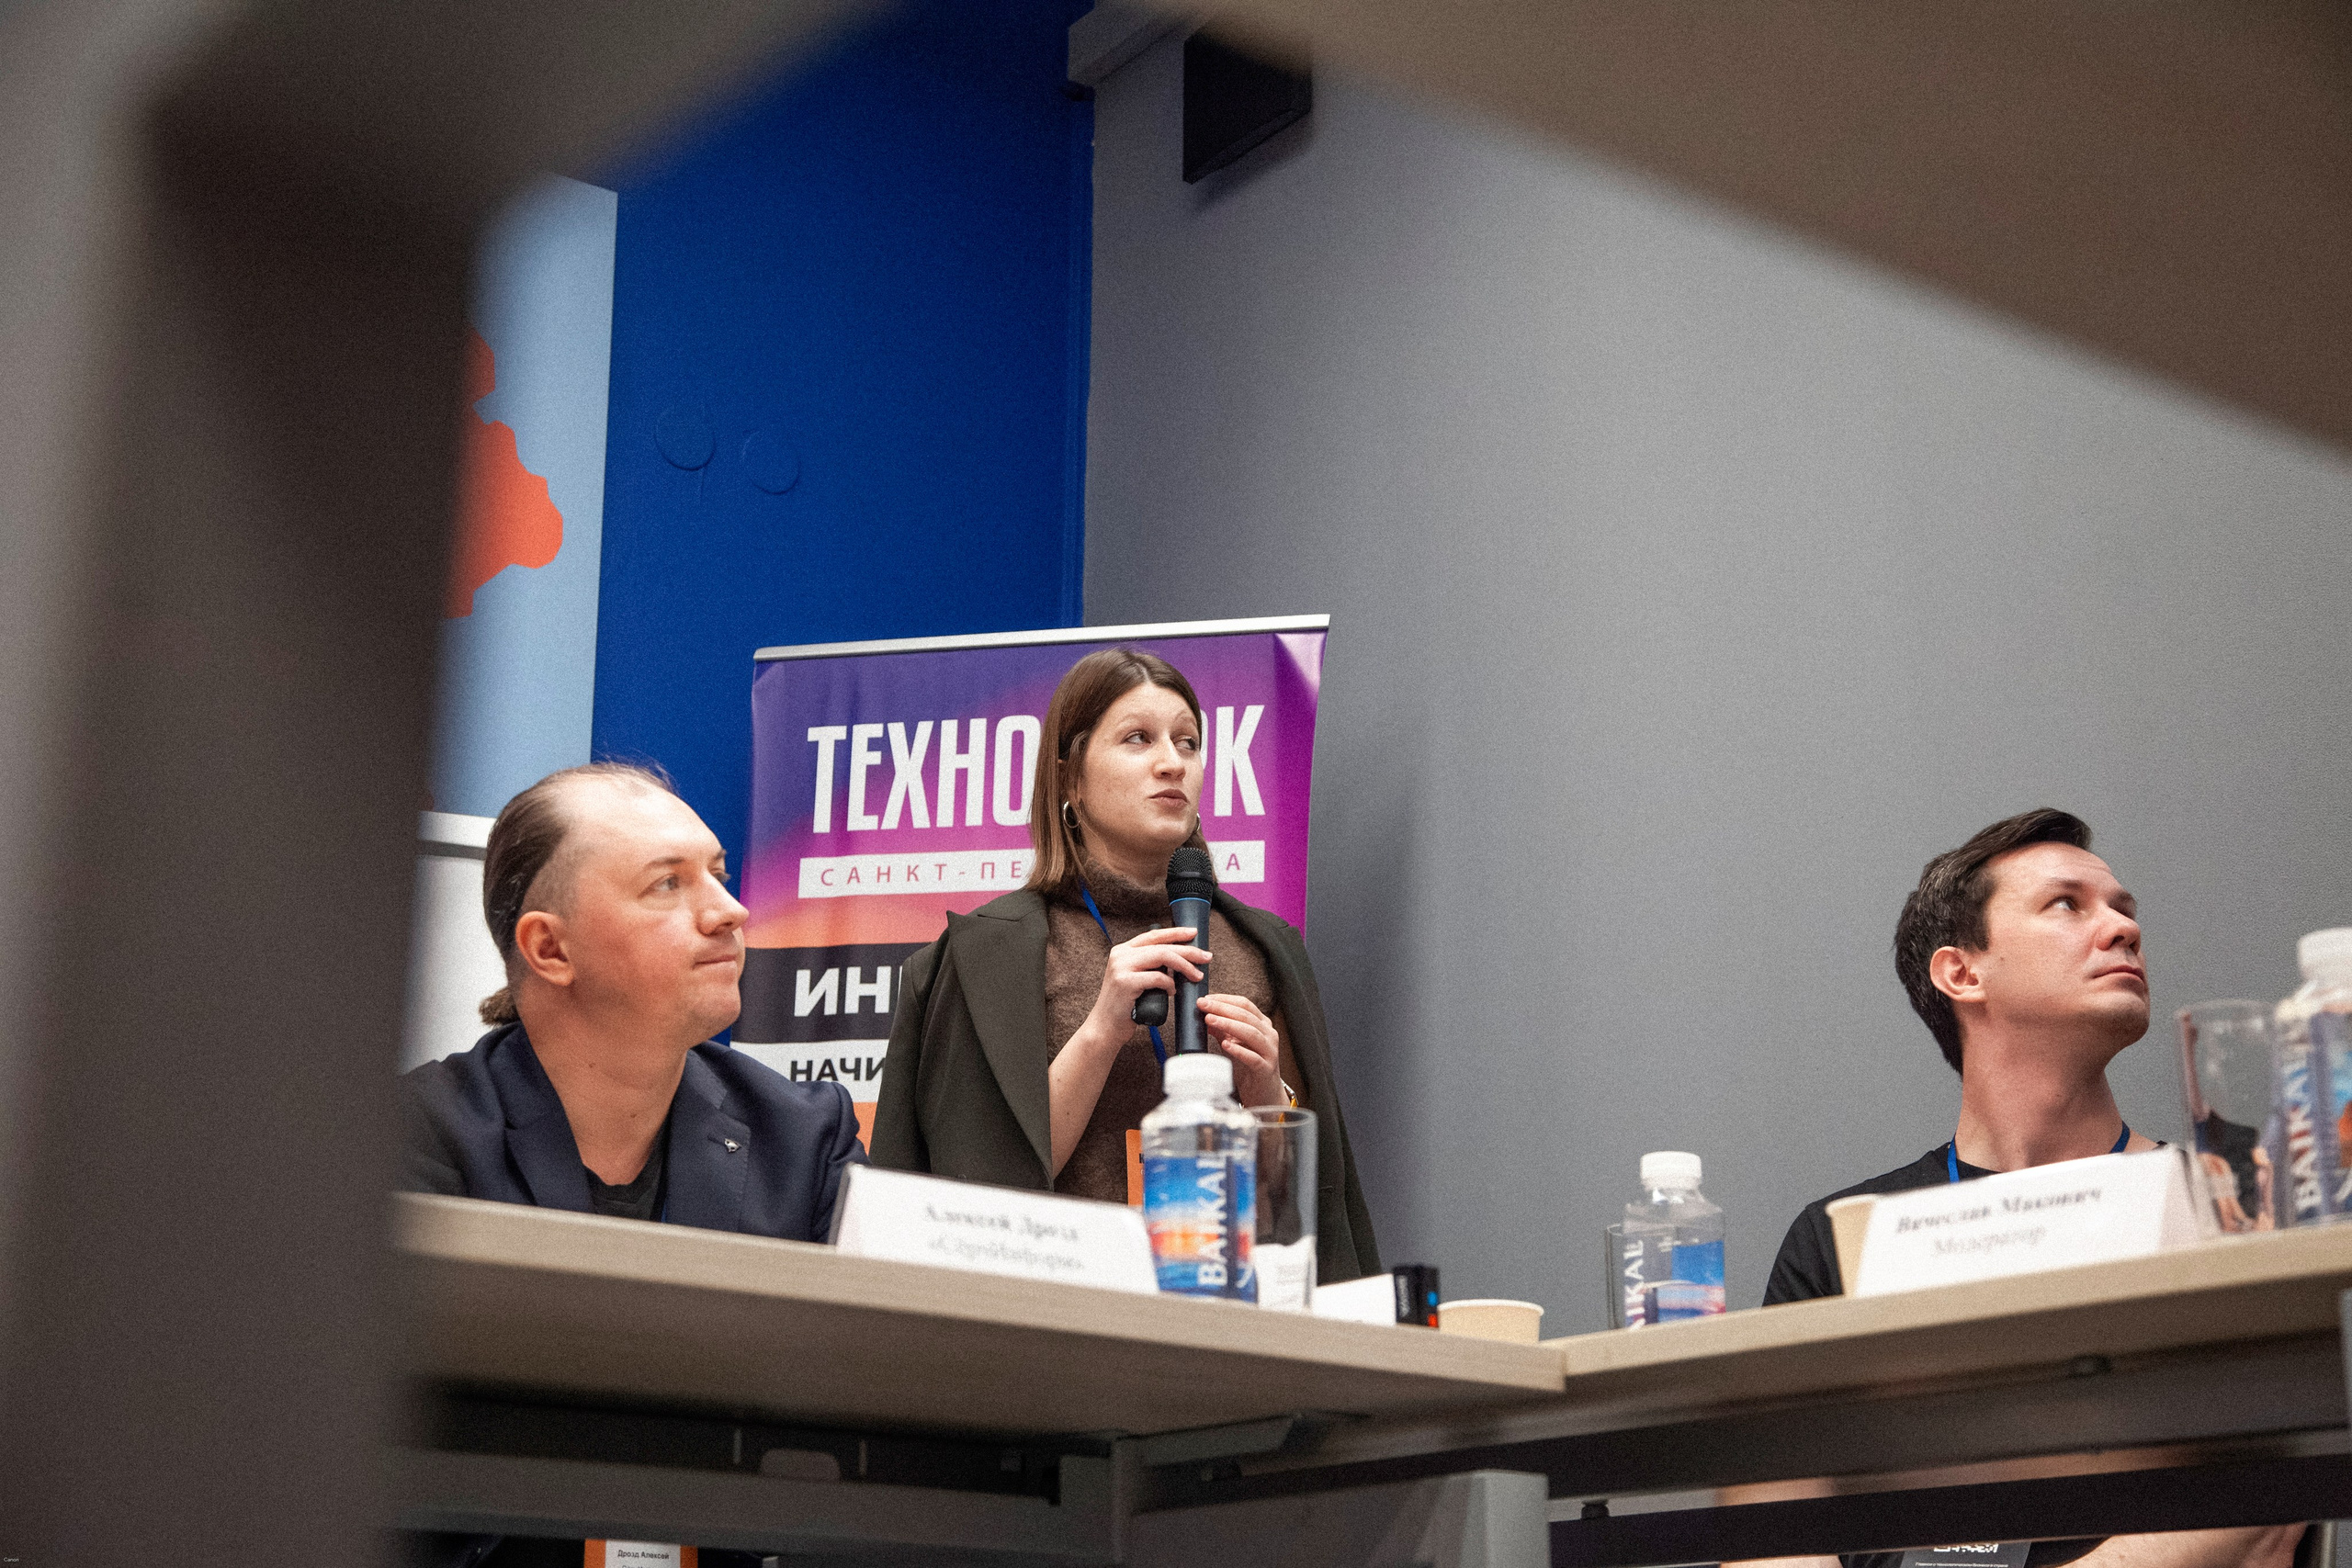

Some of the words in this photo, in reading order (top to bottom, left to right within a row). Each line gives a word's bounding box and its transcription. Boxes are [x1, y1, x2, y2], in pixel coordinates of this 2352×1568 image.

[806, 704, 1266, 834] ТЕХНОК
[820, 853, 1241, 886] САНКТ-ПЕА
[794, 965, 903, 1017] ИН
[790, 1057, 886, 1082] НАЧИ
[1195, 1152, 1227, 1287] BAIKAL
[616, 1550, 639, 1559] Дрозд
[640, 1551, 670, 1560] Алексей
